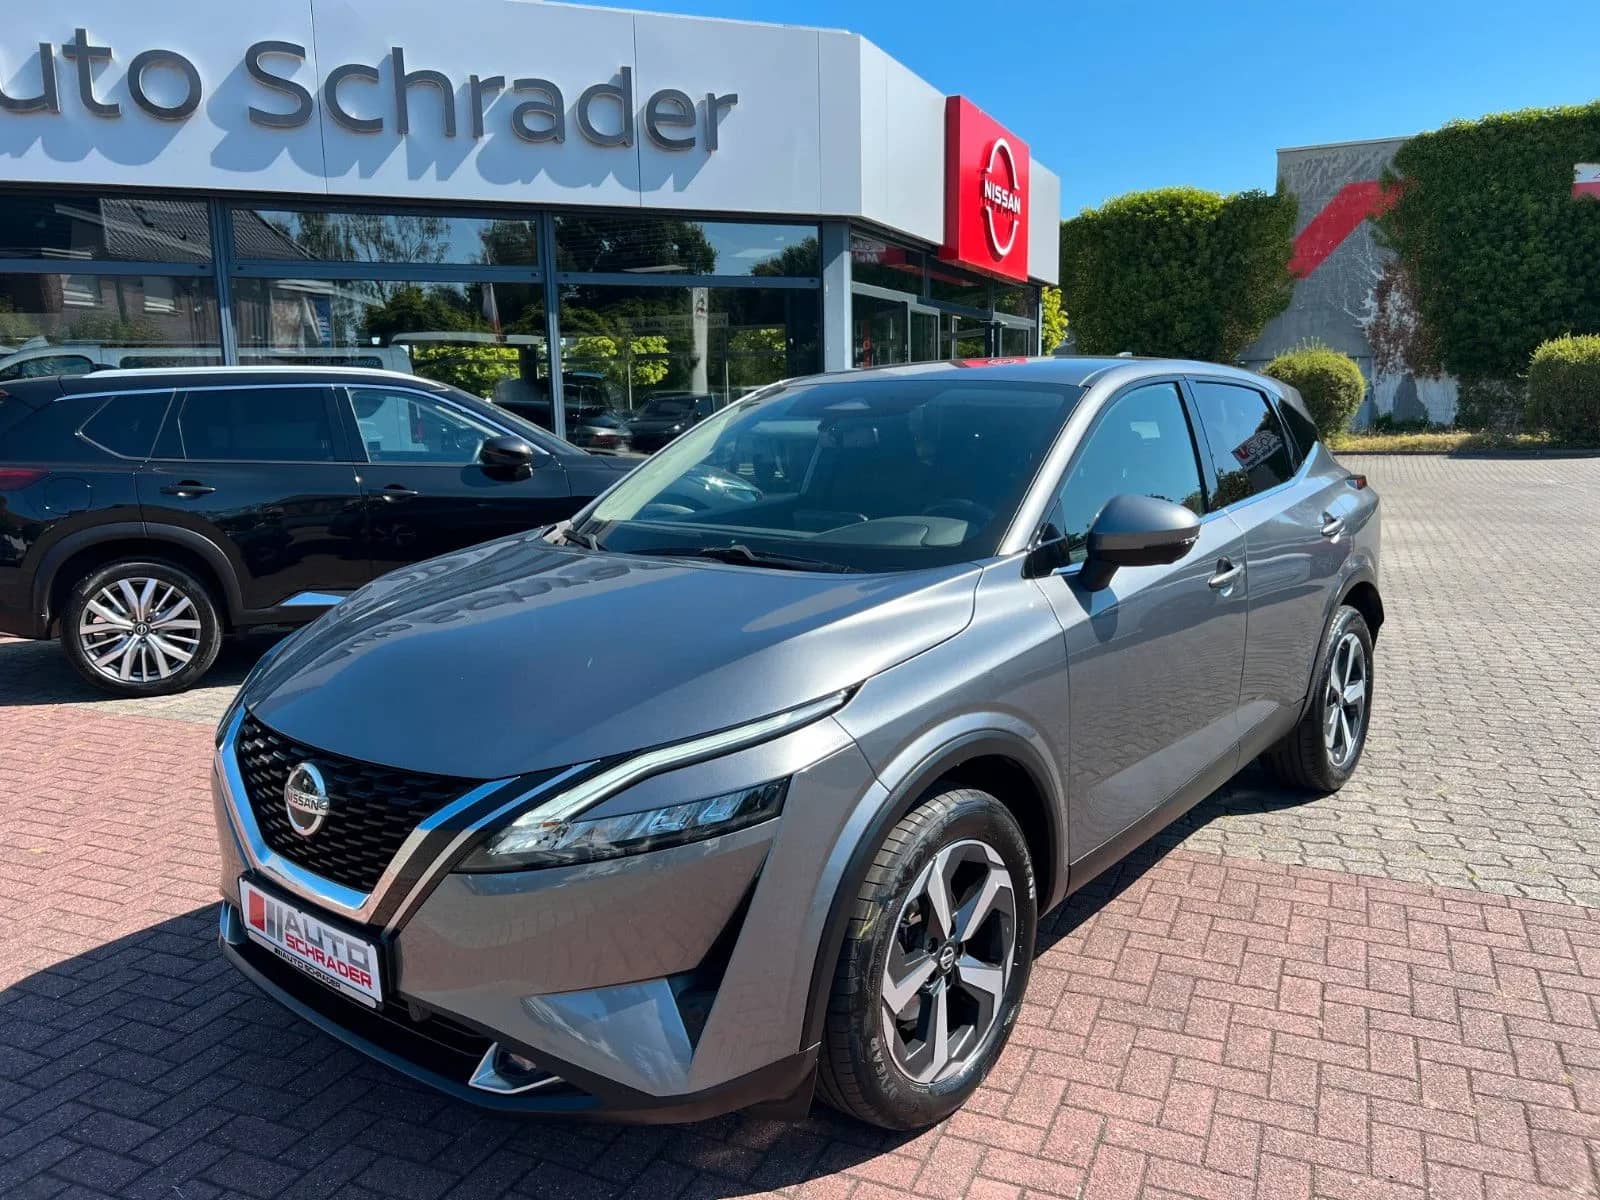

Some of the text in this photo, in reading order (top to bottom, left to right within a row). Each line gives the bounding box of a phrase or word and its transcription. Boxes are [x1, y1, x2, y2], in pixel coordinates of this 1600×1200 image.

[244, 40, 738, 152] Schrader
[984, 178, 1021, 214] NISSAN
[284, 909, 371, 973] AUTO
[285, 931, 373, 989] SCHRADER
